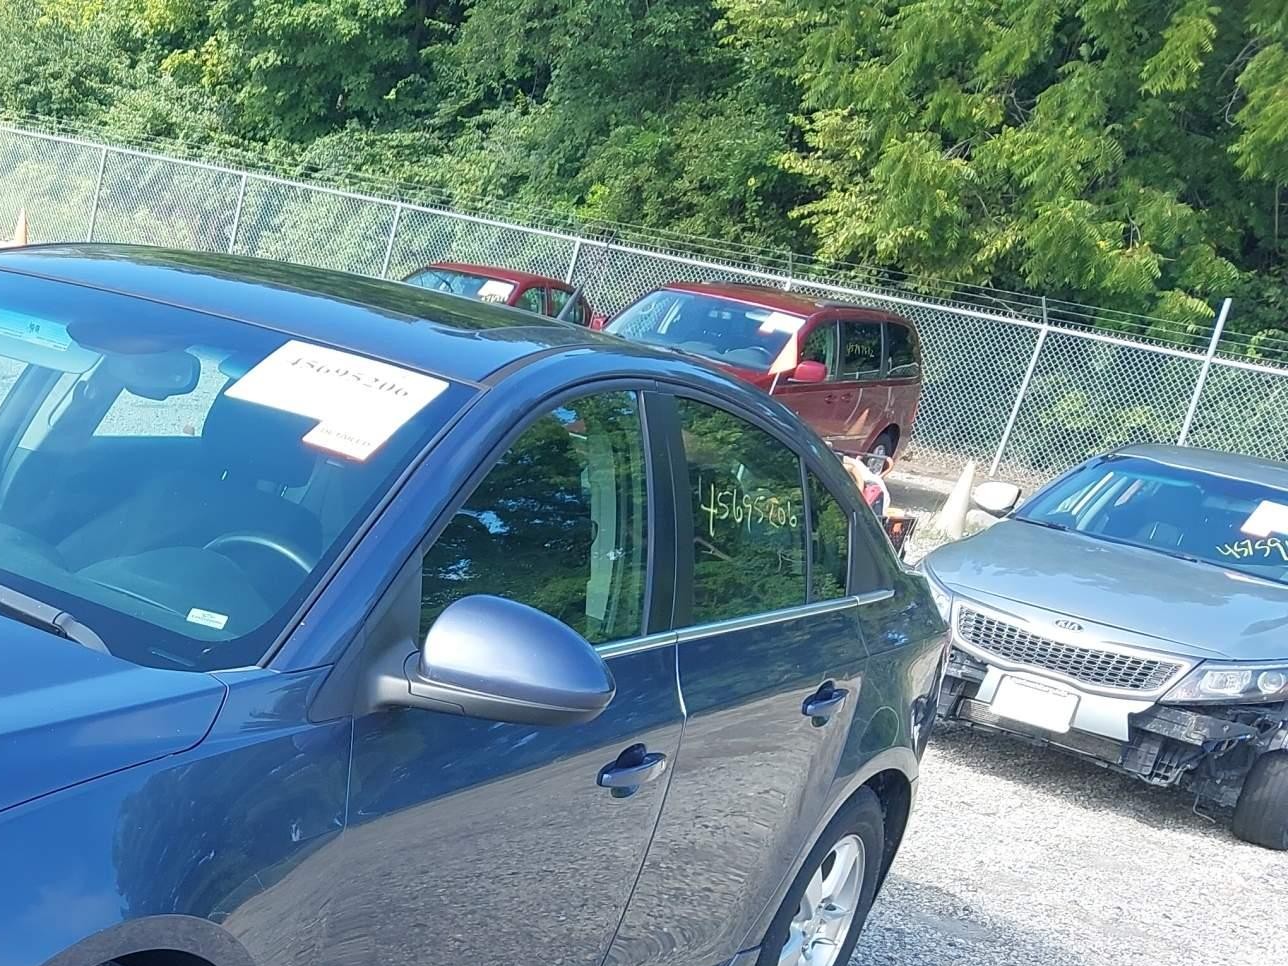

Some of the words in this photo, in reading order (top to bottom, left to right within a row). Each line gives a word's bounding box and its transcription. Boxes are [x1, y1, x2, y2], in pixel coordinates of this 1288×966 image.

[290, 356, 409, 398] 45695206
[699, 475, 798, 537] 45695206
[1055, 619, 1082, 631] KIA
